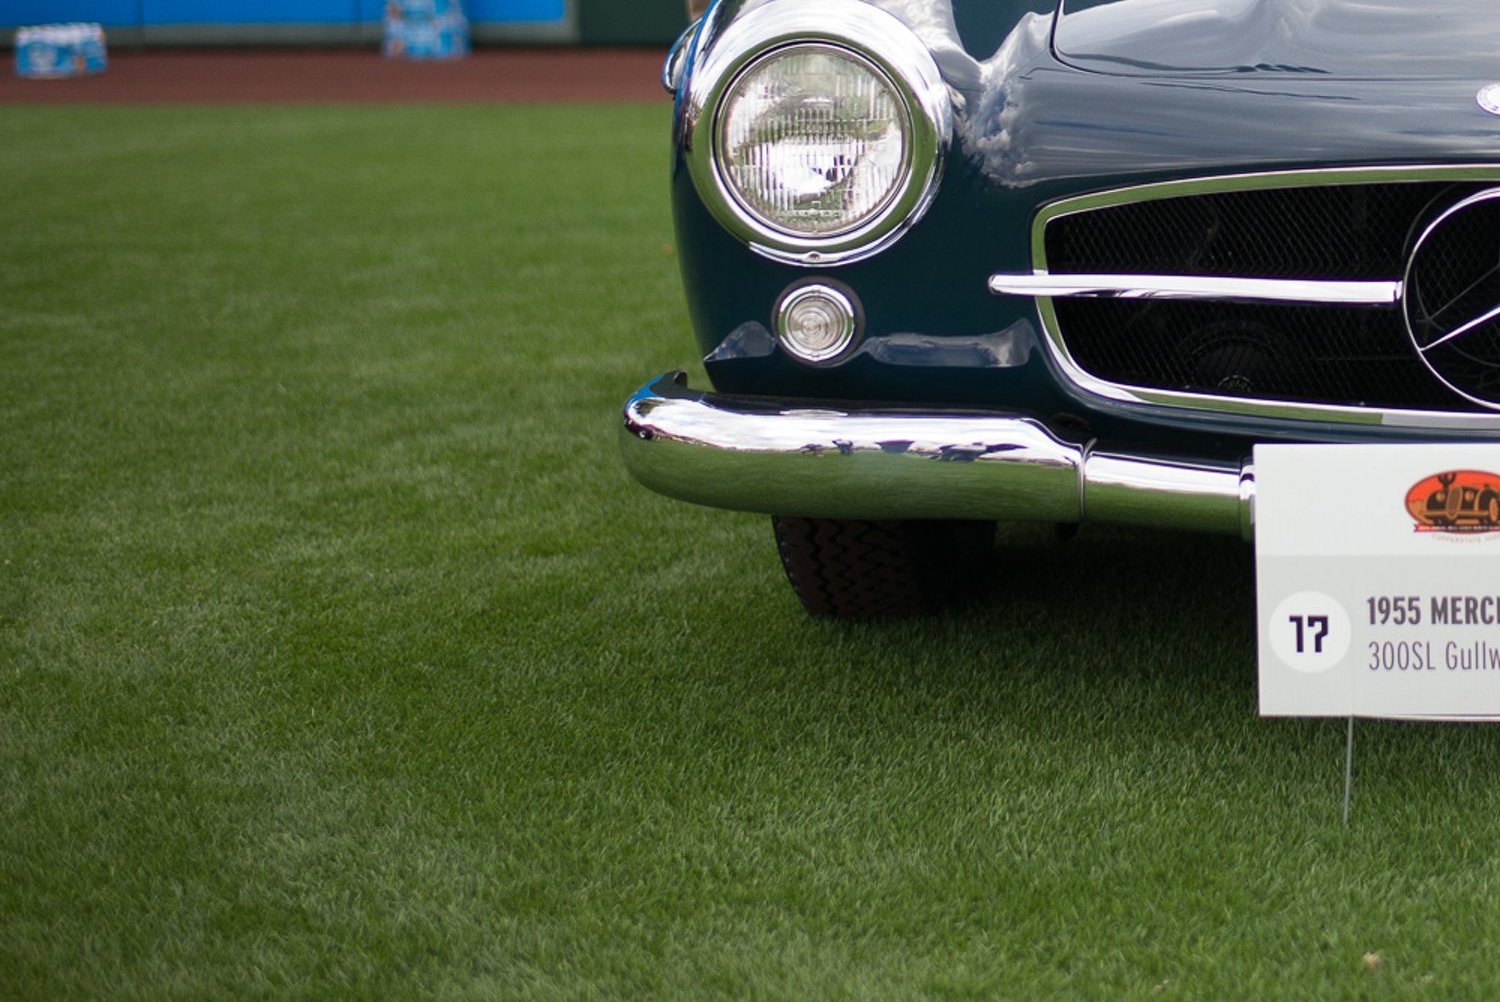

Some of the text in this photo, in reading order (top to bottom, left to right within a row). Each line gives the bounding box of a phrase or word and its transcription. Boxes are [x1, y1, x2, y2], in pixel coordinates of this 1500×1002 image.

[1366, 596, 1422, 625] 1955
[1288, 615, 1329, 654] 17
[1368, 641, 1436, 671] 300SL
